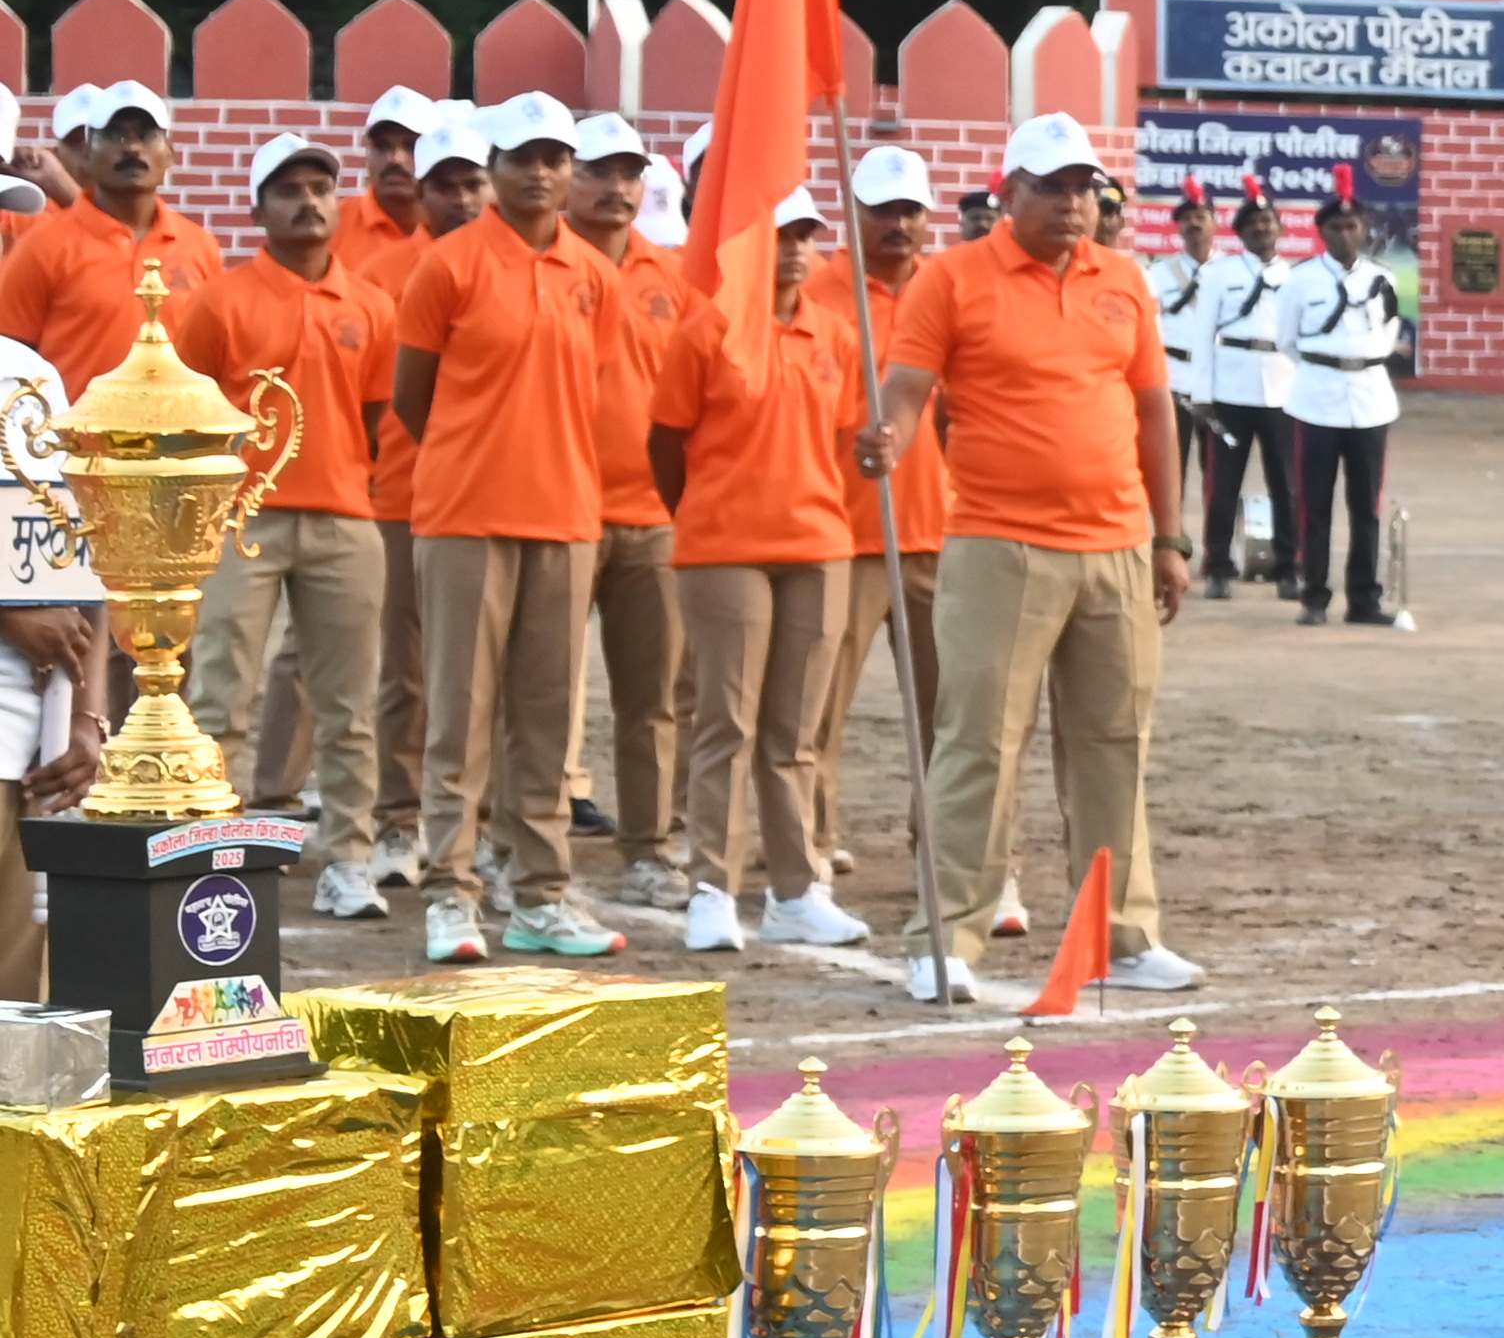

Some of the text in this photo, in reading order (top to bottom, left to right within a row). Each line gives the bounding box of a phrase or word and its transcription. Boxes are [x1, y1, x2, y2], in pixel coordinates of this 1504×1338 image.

[1223, 1, 1494, 57] अकोला पोलीस
[1221, 48, 1492, 90] कवायत मैदान
[1197, 121, 1273, 159] जिल्हा
[1274, 125, 1361, 160] पोलीस
[214, 851, 243, 867] 2025
[143, 1041, 203, 1068] जनरल
